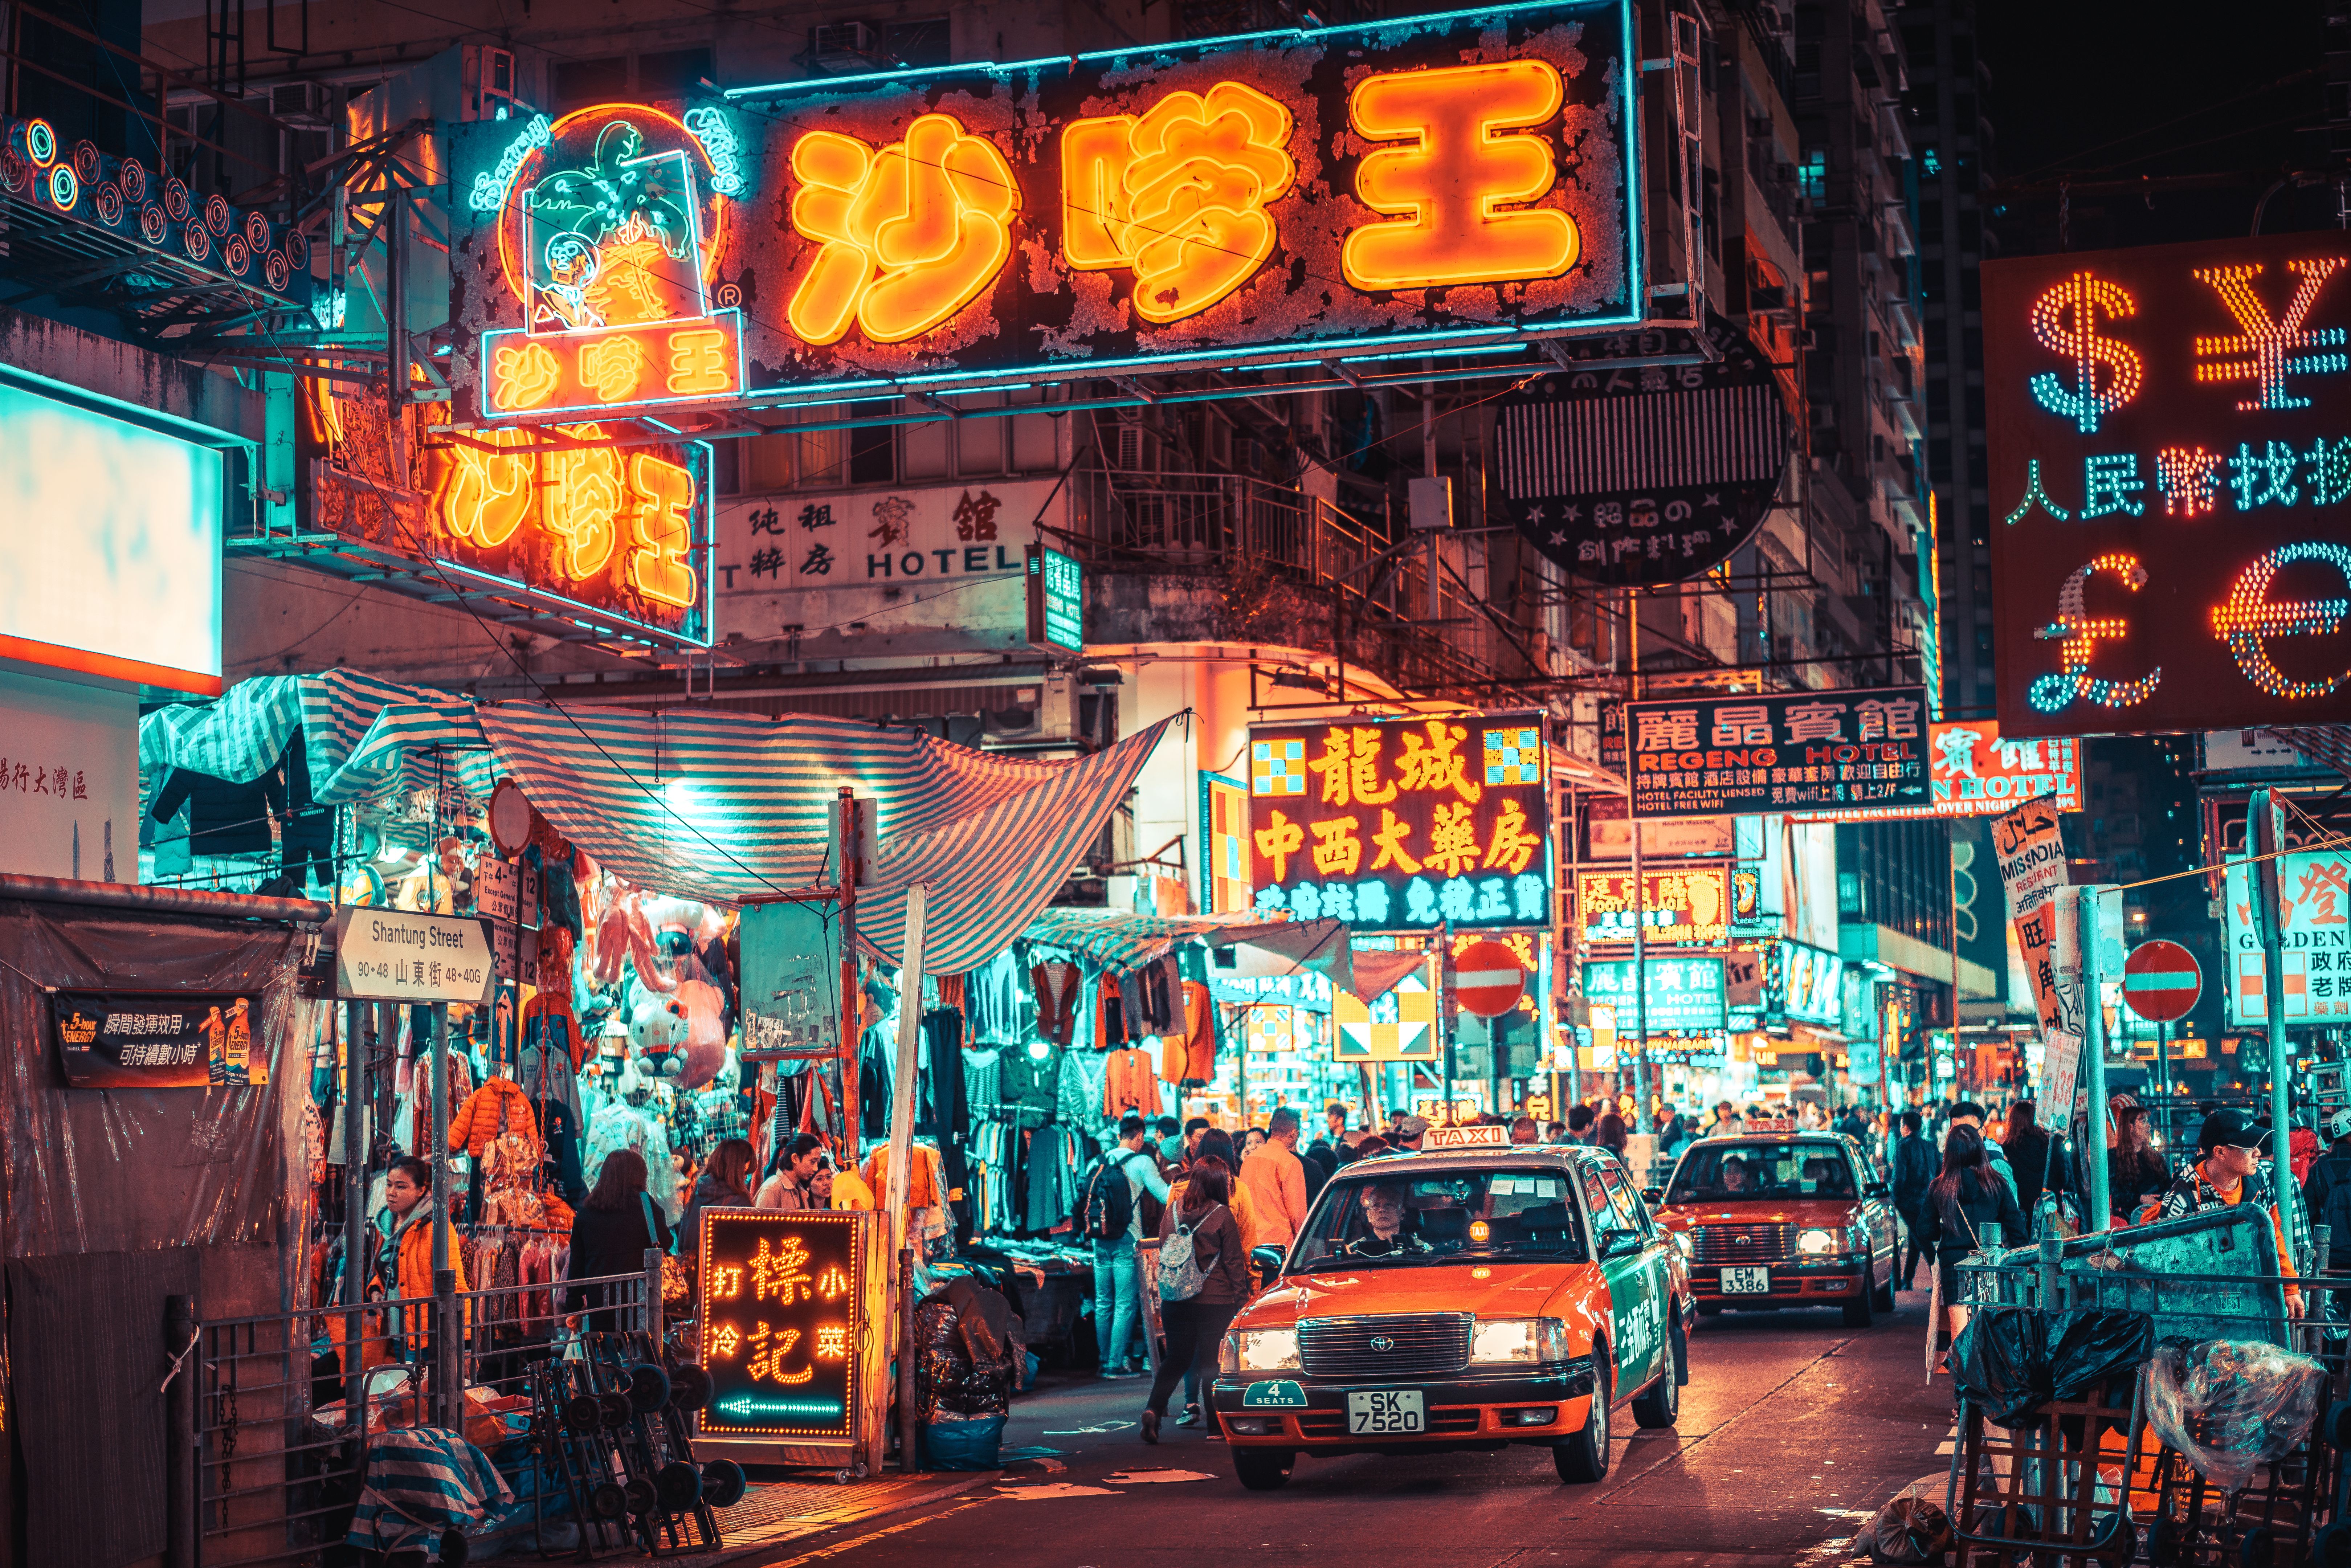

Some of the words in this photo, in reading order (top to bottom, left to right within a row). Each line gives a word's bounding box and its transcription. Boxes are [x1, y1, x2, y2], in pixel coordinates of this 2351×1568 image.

[789, 58, 1580, 346] 沙嗲王
[495, 329, 731, 410] 沙嗲王
[868, 545, 1021, 578] HOTEL
[1635, 697, 1920, 752] 麗晶賓館
[1309, 721, 1481, 806] 龍城
[1639, 748, 1777, 772] REGENG
[1806, 742, 1918, 770] HOTEL
[1637, 792, 1671, 801] HOTEL
[1674, 789, 1719, 800] FACILITY
[1961, 773, 2076, 799] HOTEL
[1637, 802, 1672, 811] HOTEL
[1674, 800, 1699, 810] FREE
[1700, 799, 1724, 809] WIFI
[1937, 801, 1973, 815] OVER
[1254, 799, 1540, 883] 中西大藥房
[485, 885, 499, 898] Except
[500, 890, 516, 902] General
[526, 876, 535, 894] 12
[2237, 861, 2349, 930] 登
[492, 900, 525, 918] 公眾假期
[1586, 899, 1625, 913] FOOT
[1627, 898, 1688, 912] PLACE
[372, 920, 425, 949] Shantung
[429, 926, 464, 949] Street
[495, 923, 508, 932] eneral
[2239, 930, 2345, 950] GDEN
[395, 958, 442, 988] 山東街
[525, 961, 534, 980] 12
[1666, 993, 1721, 1005] HOTEL
[70, 1012, 97, 1030] 5-hour
[65, 1030, 96, 1043] ENERGY
[233, 1025, 250, 1040] 5-hour
[230, 1041, 248, 1050] ENERGY
[1748, 1119, 1794, 1130] TAXI
[1429, 1128, 1501, 1146] TAXI
[1472, 1226, 1487, 1237] TAXI
[1734, 1268, 1754, 1278] EM
[1725, 1278, 1766, 1292] 3386
[1268, 1383, 1281, 1396] 4
[1370, 1392, 1401, 1412] SK
[1355, 1411, 1419, 1432] 7520
